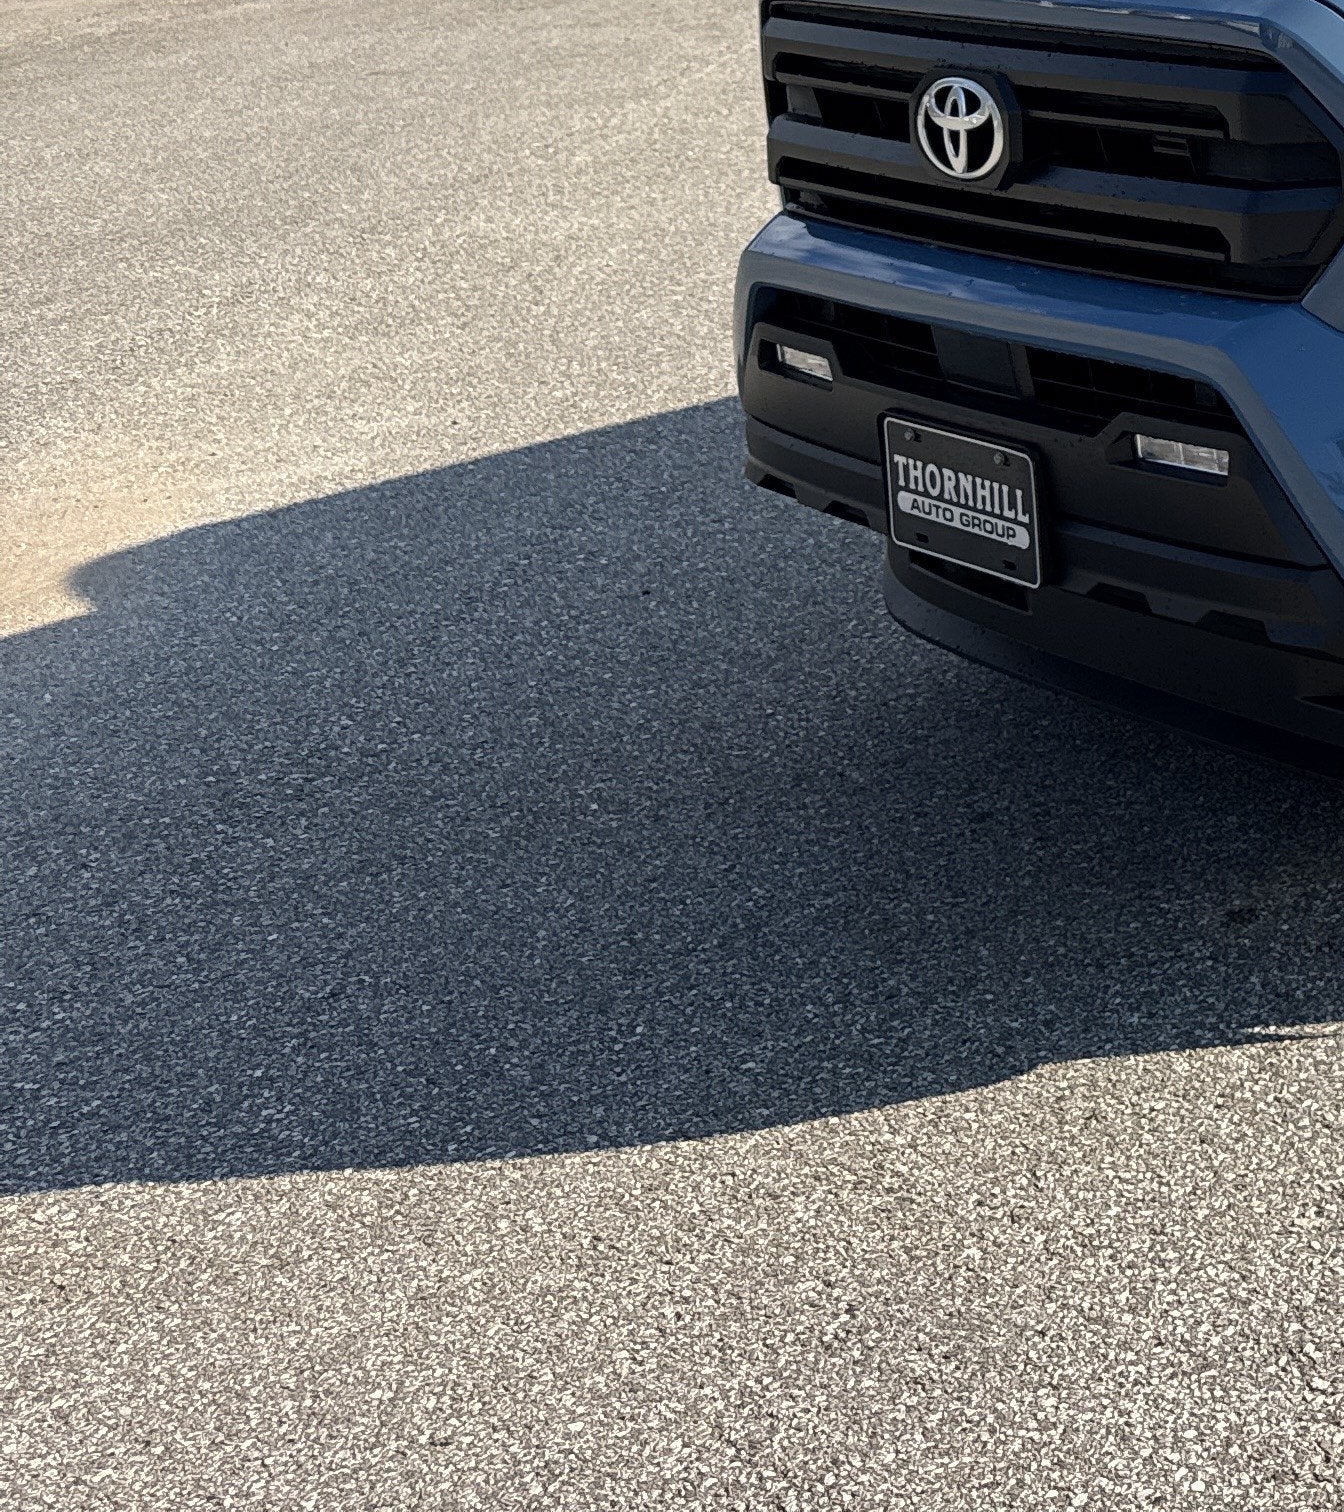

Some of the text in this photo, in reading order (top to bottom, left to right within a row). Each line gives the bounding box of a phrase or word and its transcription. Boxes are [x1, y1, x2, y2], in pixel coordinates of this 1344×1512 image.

[893, 453, 1030, 524] THORNHILL
[910, 497, 1017, 541] AUTO GROUP
